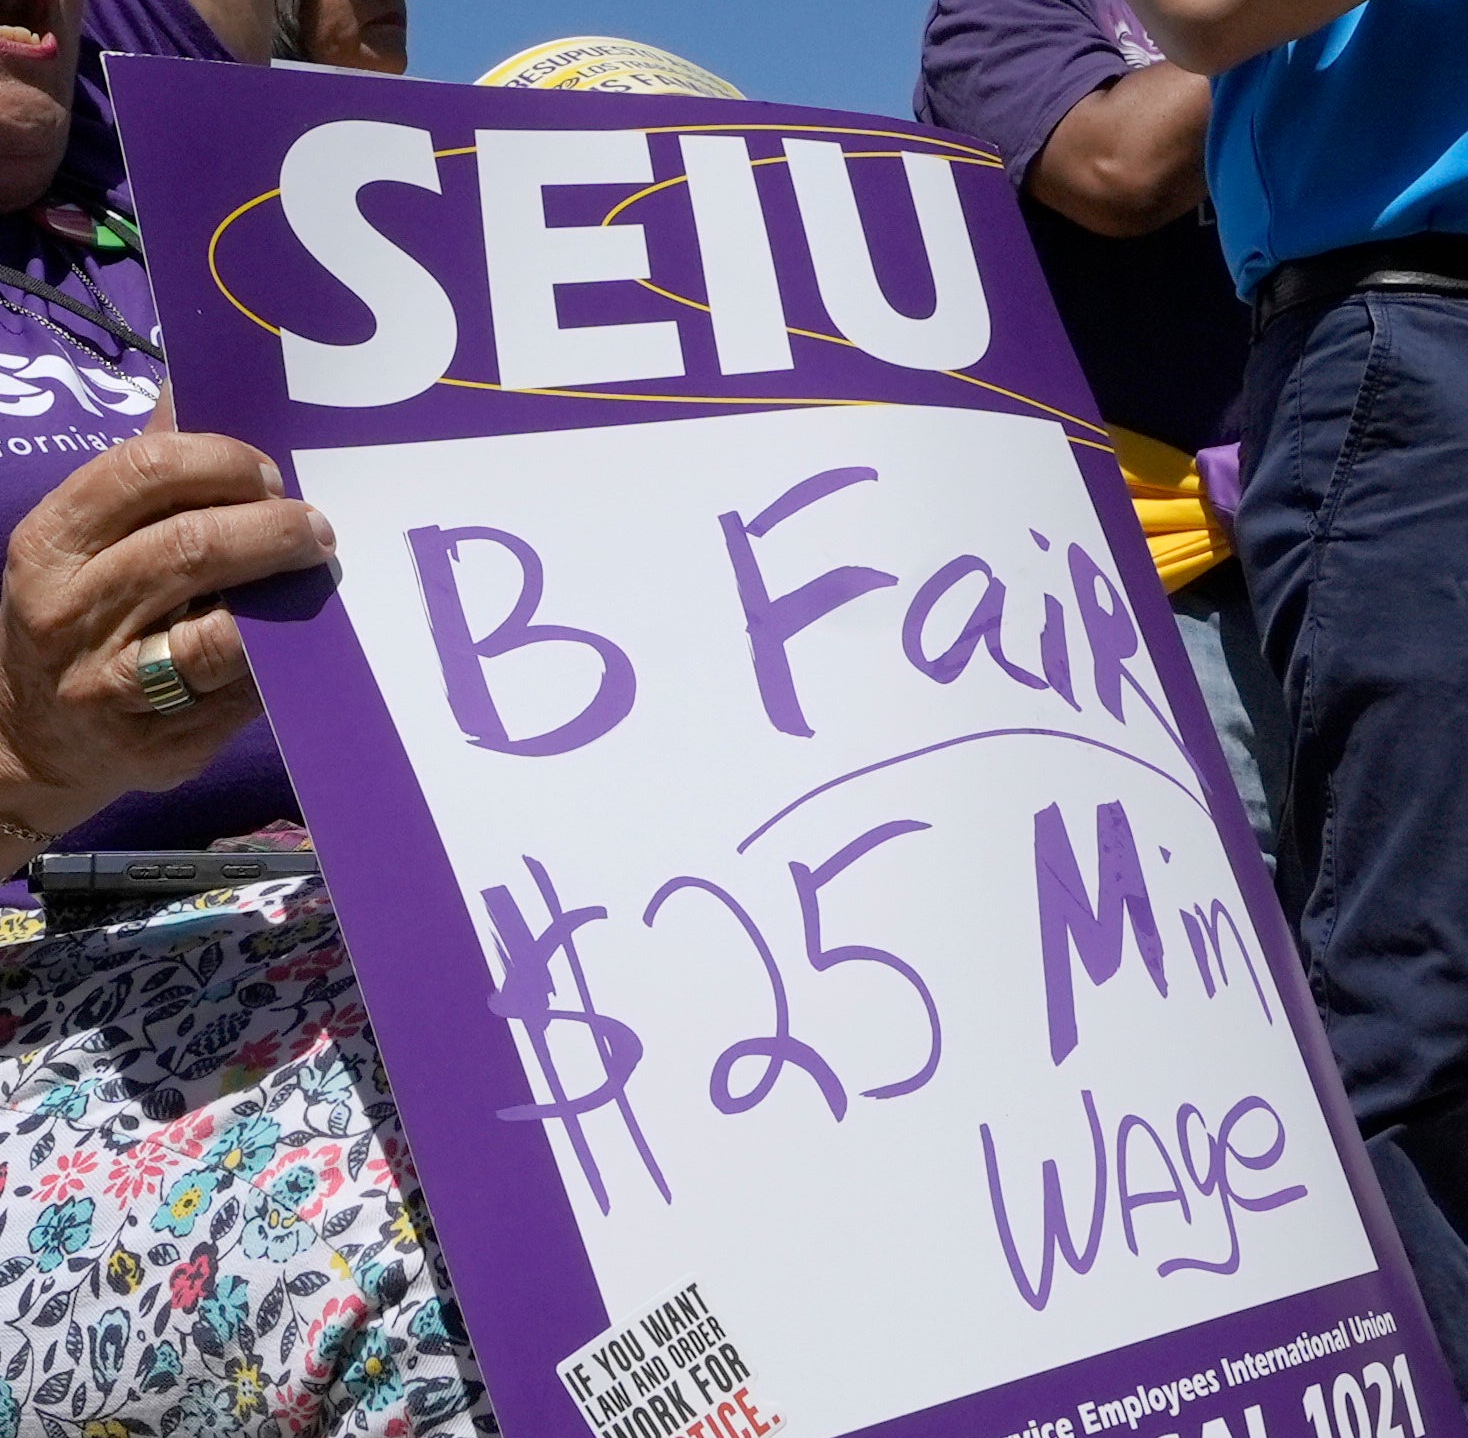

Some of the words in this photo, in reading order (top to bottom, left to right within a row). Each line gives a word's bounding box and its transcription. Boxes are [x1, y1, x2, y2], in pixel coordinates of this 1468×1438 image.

[277, 119, 993, 408] SEIU
[404, 523, 637, 757] B
[479, 820, 942, 1217] $25
[1034, 801, 1272, 1066] Min
[565, 1363, 594, 1402] IF
[592, 1330, 645, 1380] YOU
[640, 1282, 710, 1348] WANT
[585, 1381, 633, 1429] LAW
[631, 1356, 671, 1397] AND
[667, 1315, 727, 1369] ORDER
[688, 1343, 752, 1406] FOR
[1077, 1366, 1221, 1430] Employees
[1220, 1320, 1351, 1388] International
[1347, 1310, 1397, 1345] Union
